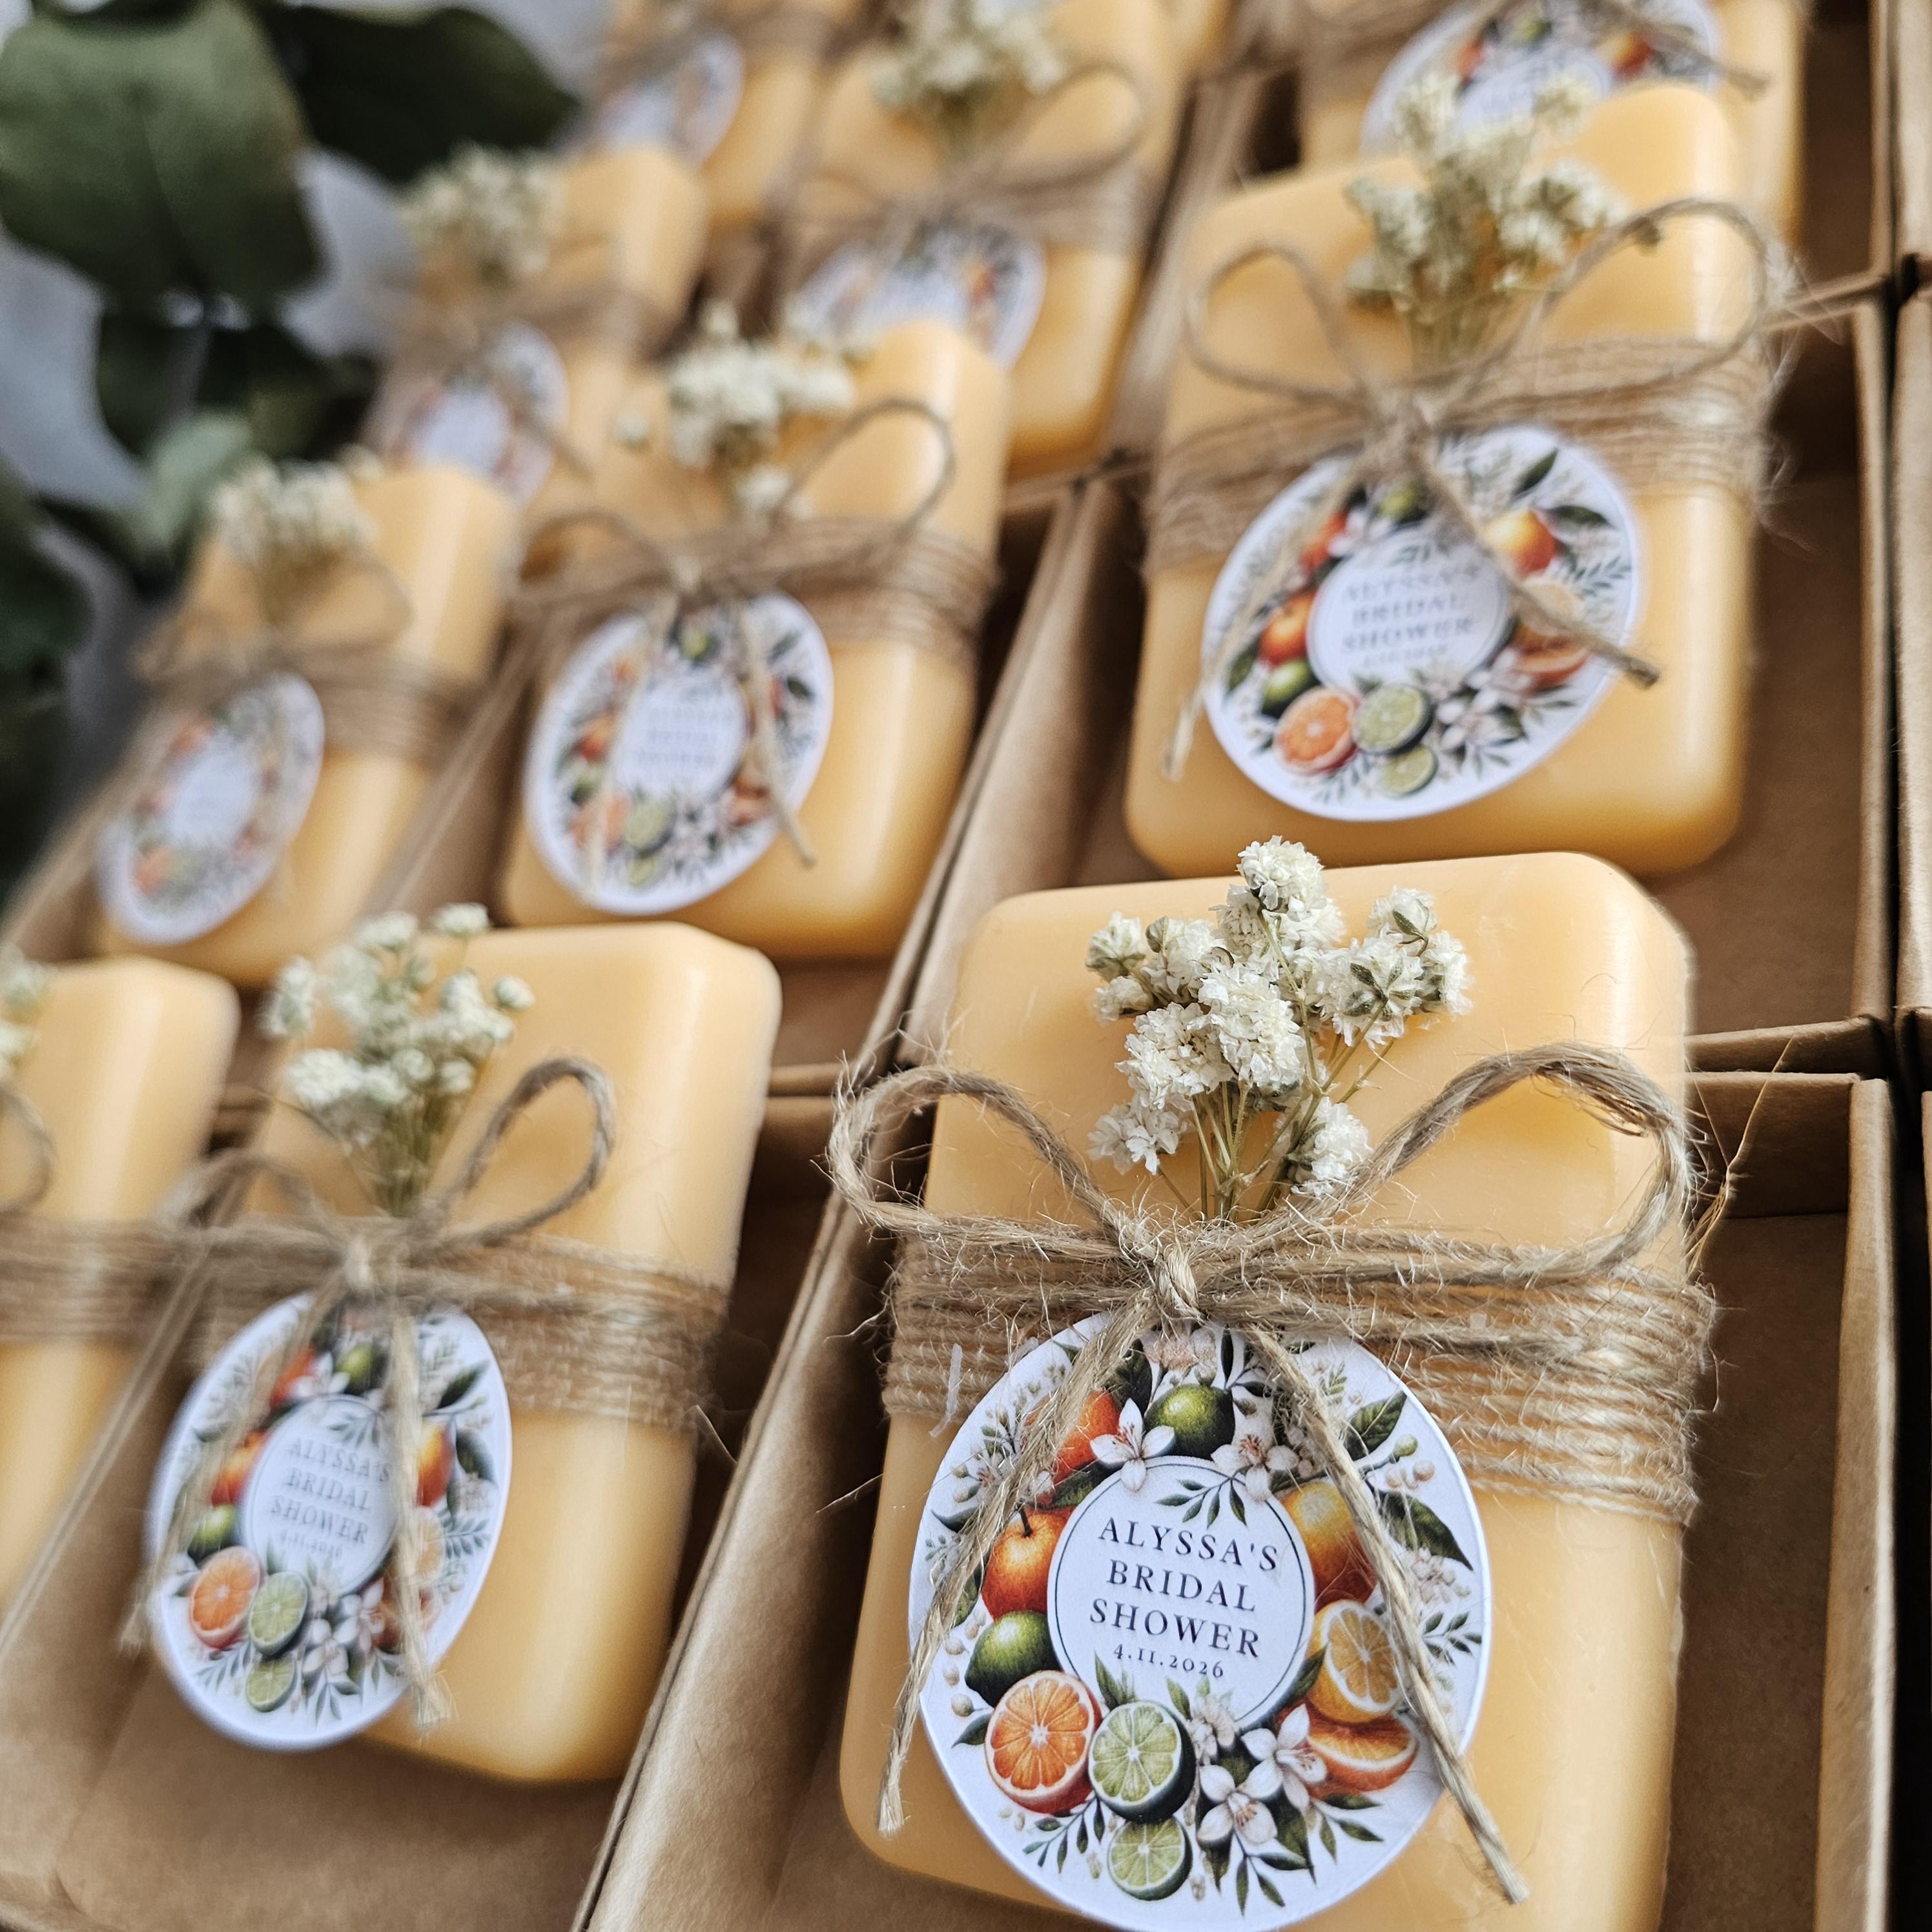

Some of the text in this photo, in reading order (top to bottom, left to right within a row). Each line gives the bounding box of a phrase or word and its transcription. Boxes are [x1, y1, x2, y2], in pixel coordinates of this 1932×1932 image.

[284, 1466, 372, 1512] BRIDAL
[271, 1494, 369, 1545] SHOWER
[1098, 1517, 1278, 1572] ALYSSA'S
[1105, 1559, 1256, 1613] BRIDAL
[1089, 1598, 1260, 1659] SHOWER
[1113, 1643, 1224, 1680] 4.11.2026
